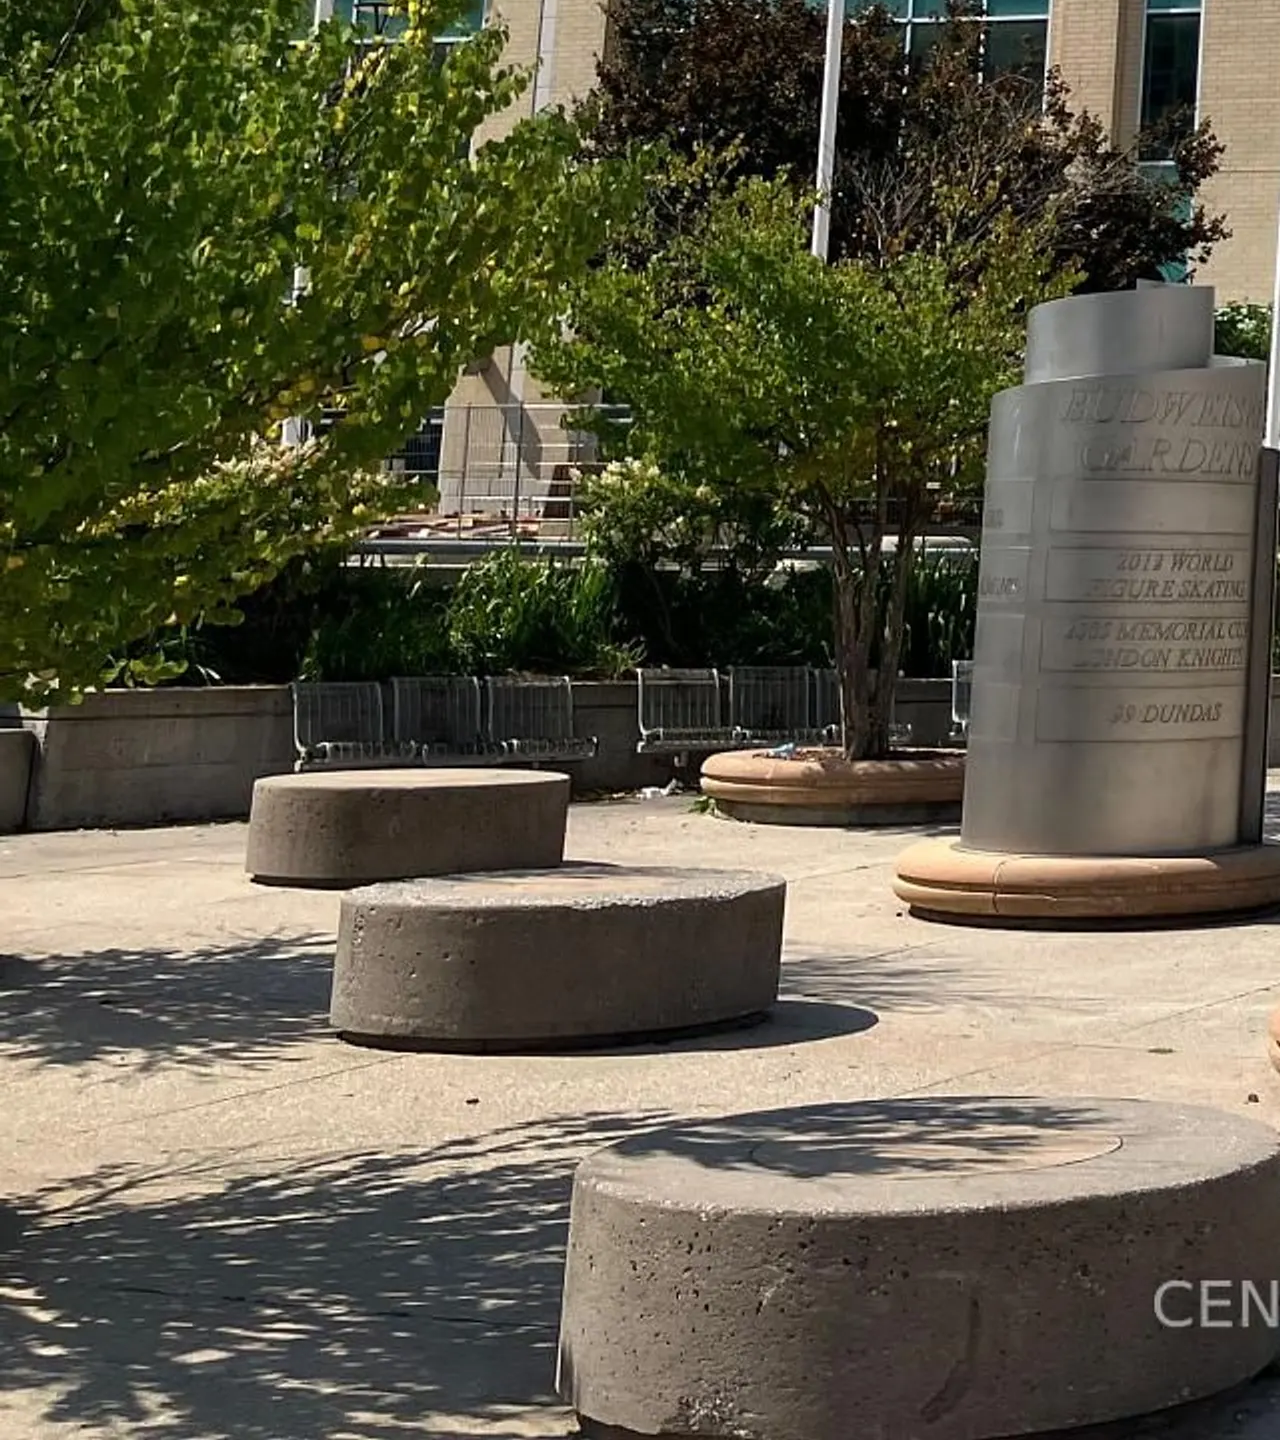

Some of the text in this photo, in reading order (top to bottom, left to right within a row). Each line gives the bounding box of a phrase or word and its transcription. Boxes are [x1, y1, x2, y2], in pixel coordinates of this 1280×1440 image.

[1170, 552, 1235, 573] WORLD
[1177, 578, 1247, 599] SKATING
[1115, 621, 1226, 642] MEMORIAL
[1177, 647, 1246, 668] KNIGHTS
[1139, 702, 1224, 724] DUNDAS
